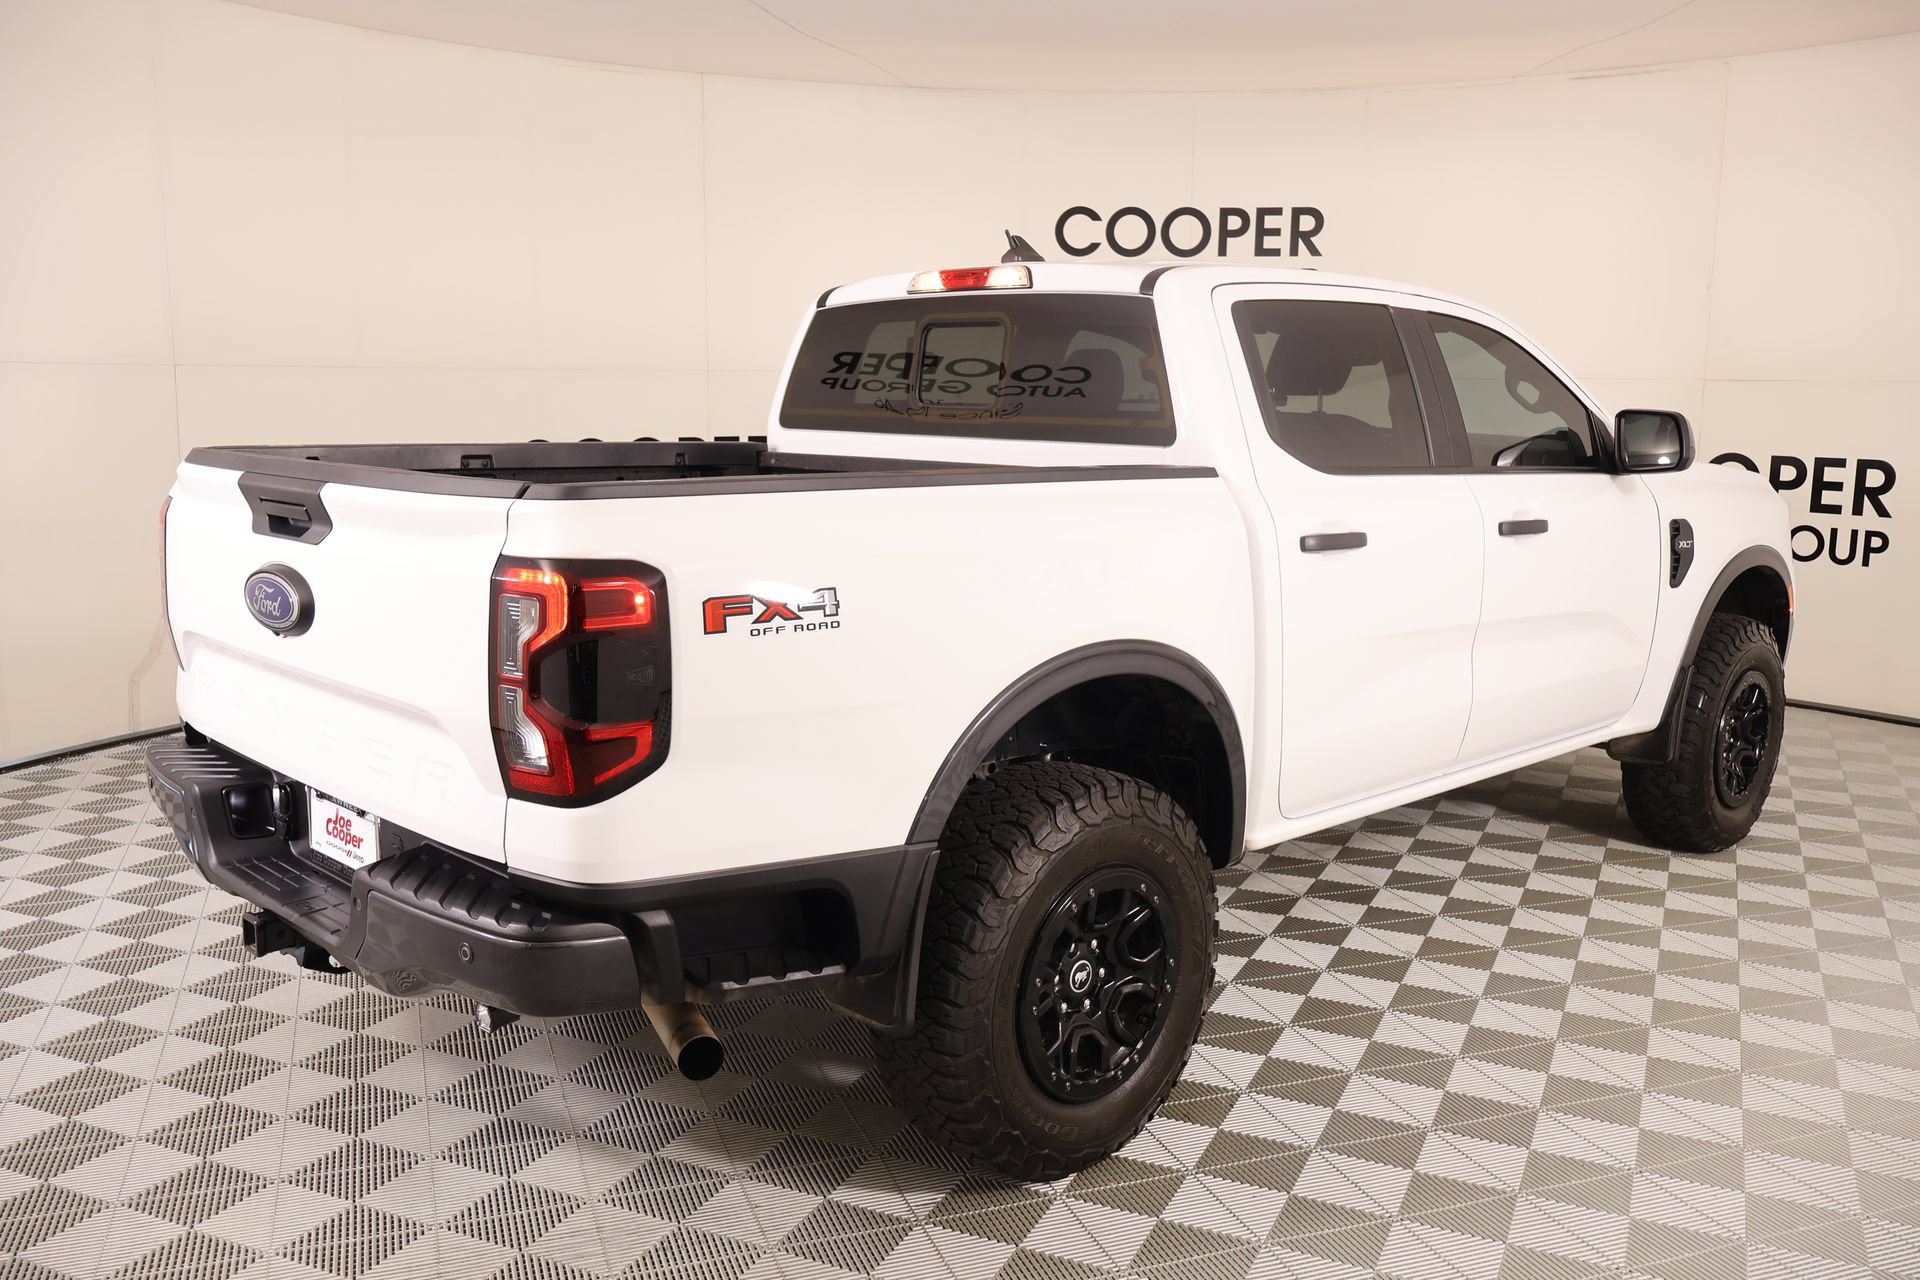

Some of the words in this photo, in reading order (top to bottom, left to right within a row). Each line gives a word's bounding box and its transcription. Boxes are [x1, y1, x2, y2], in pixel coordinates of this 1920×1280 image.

[1054, 205, 1325, 257] COOPER
[1678, 540, 1693, 549] XLT
[252, 583, 282, 617] Ford
[702, 586, 840, 636] FX4
[749, 625, 786, 637] OFF
[793, 620, 841, 633] ROAD
[325, 817, 364, 849] Cooper
[332, 807, 352, 831] Joe
